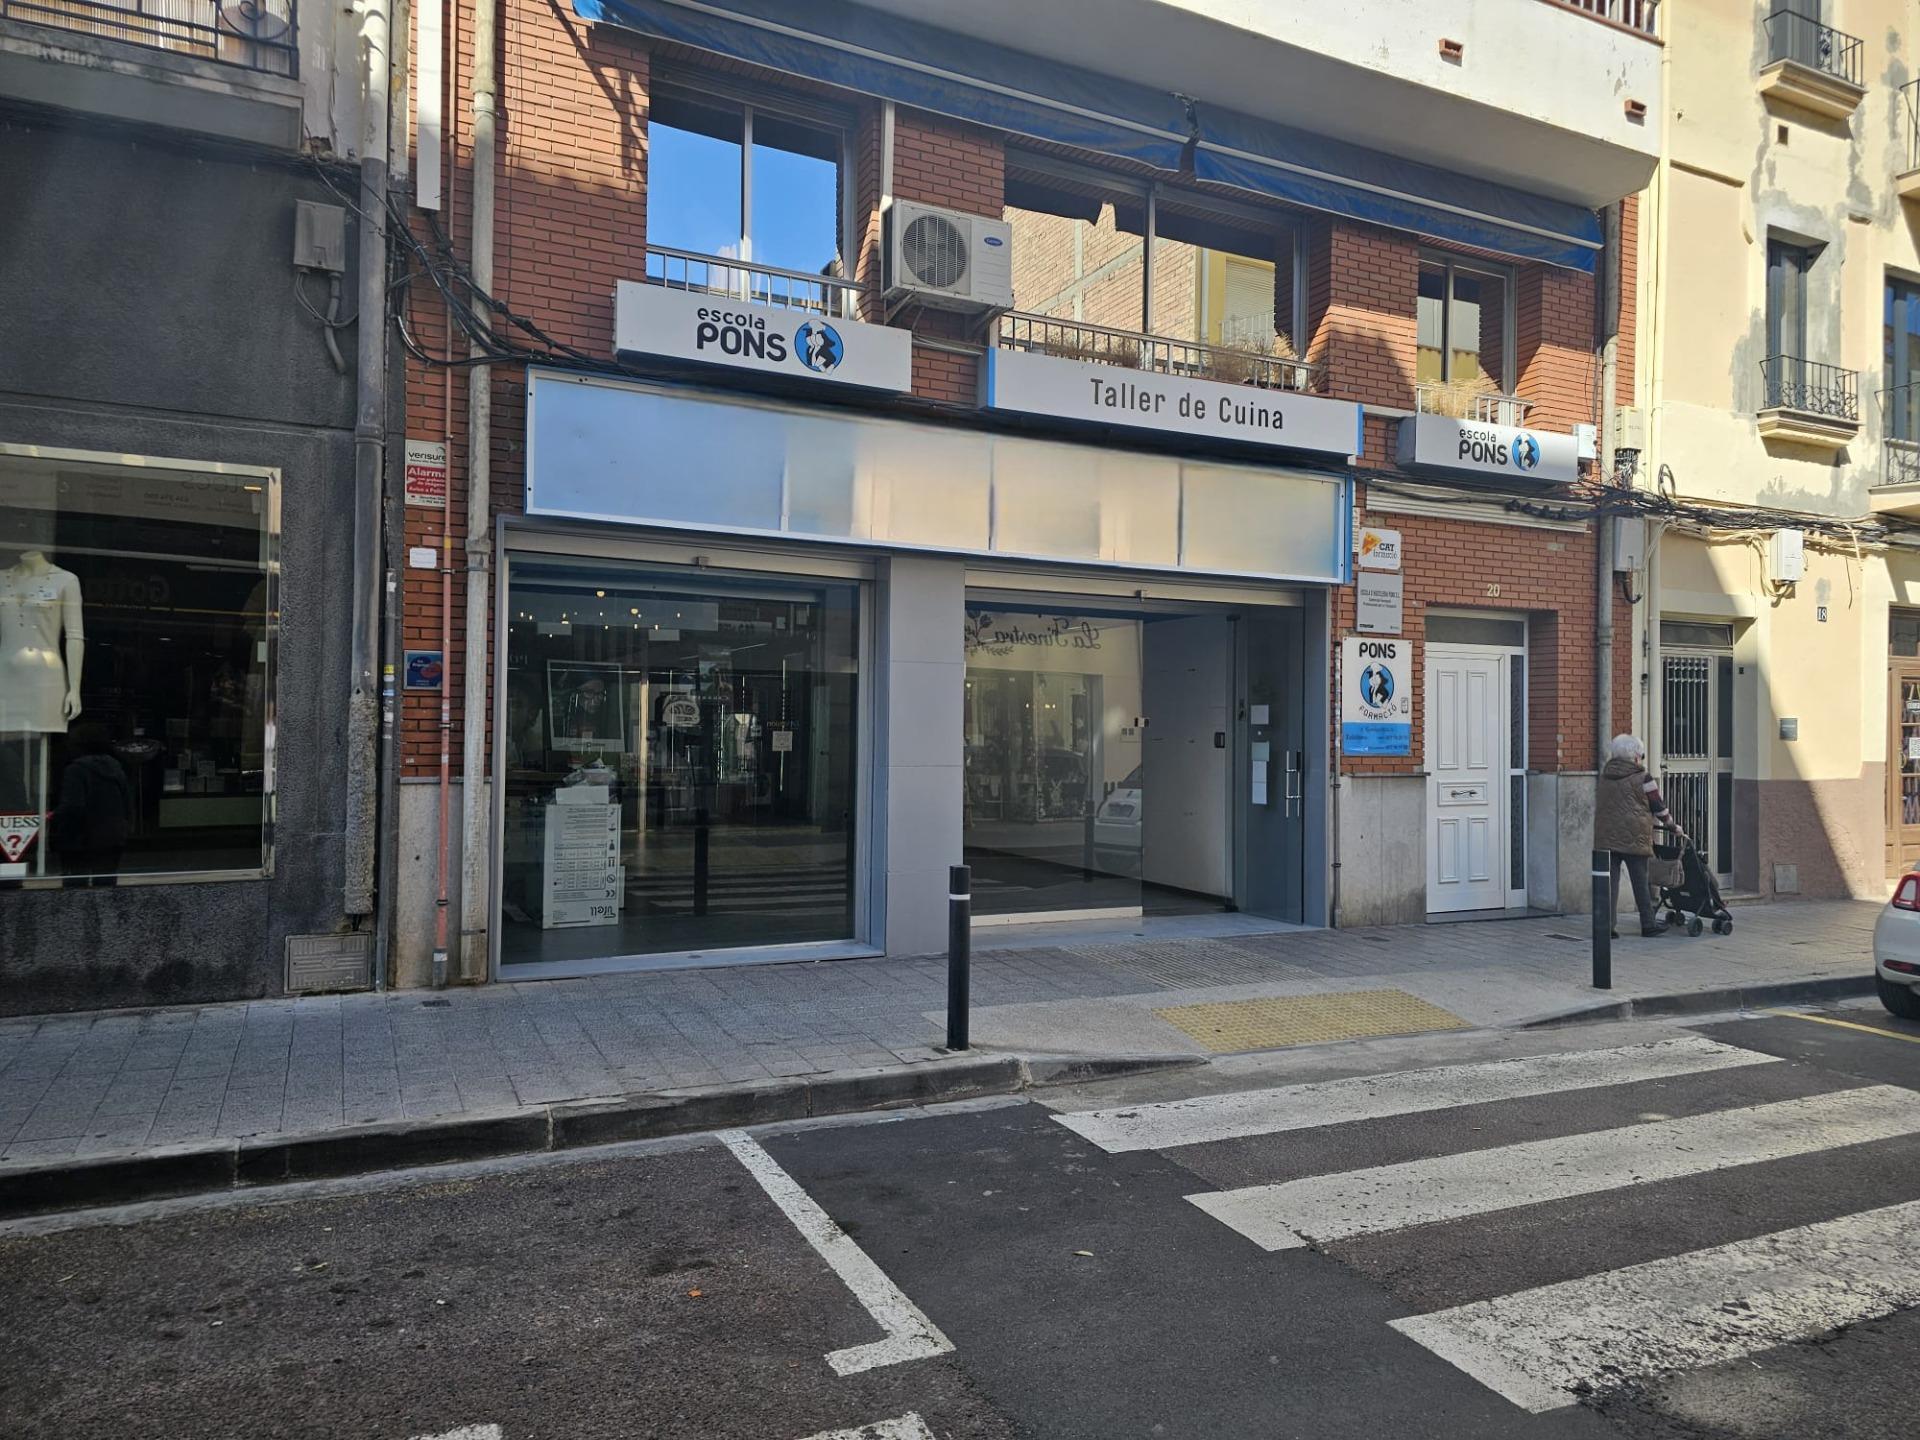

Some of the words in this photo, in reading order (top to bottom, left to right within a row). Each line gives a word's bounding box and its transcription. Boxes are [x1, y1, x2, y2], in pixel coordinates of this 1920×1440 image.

[697, 307, 765, 330] escola
[697, 322, 787, 362] PONS
[1090, 378, 1166, 413] Taller
[1179, 392, 1206, 419] de
[1219, 397, 1284, 429] Cuina
[1459, 428, 1497, 442] escola
[408, 451, 446, 461] verisure
[1458, 439, 1508, 465] PONS
[1379, 542, 1395, 551] CAT
[1487, 583, 1500, 598] 20
[1817, 607, 1827, 621] 18
[1358, 642, 1396, 659] PONS
[1359, 702, 1397, 720] FORMACIÓ
[0, 816, 40, 829] UESS
